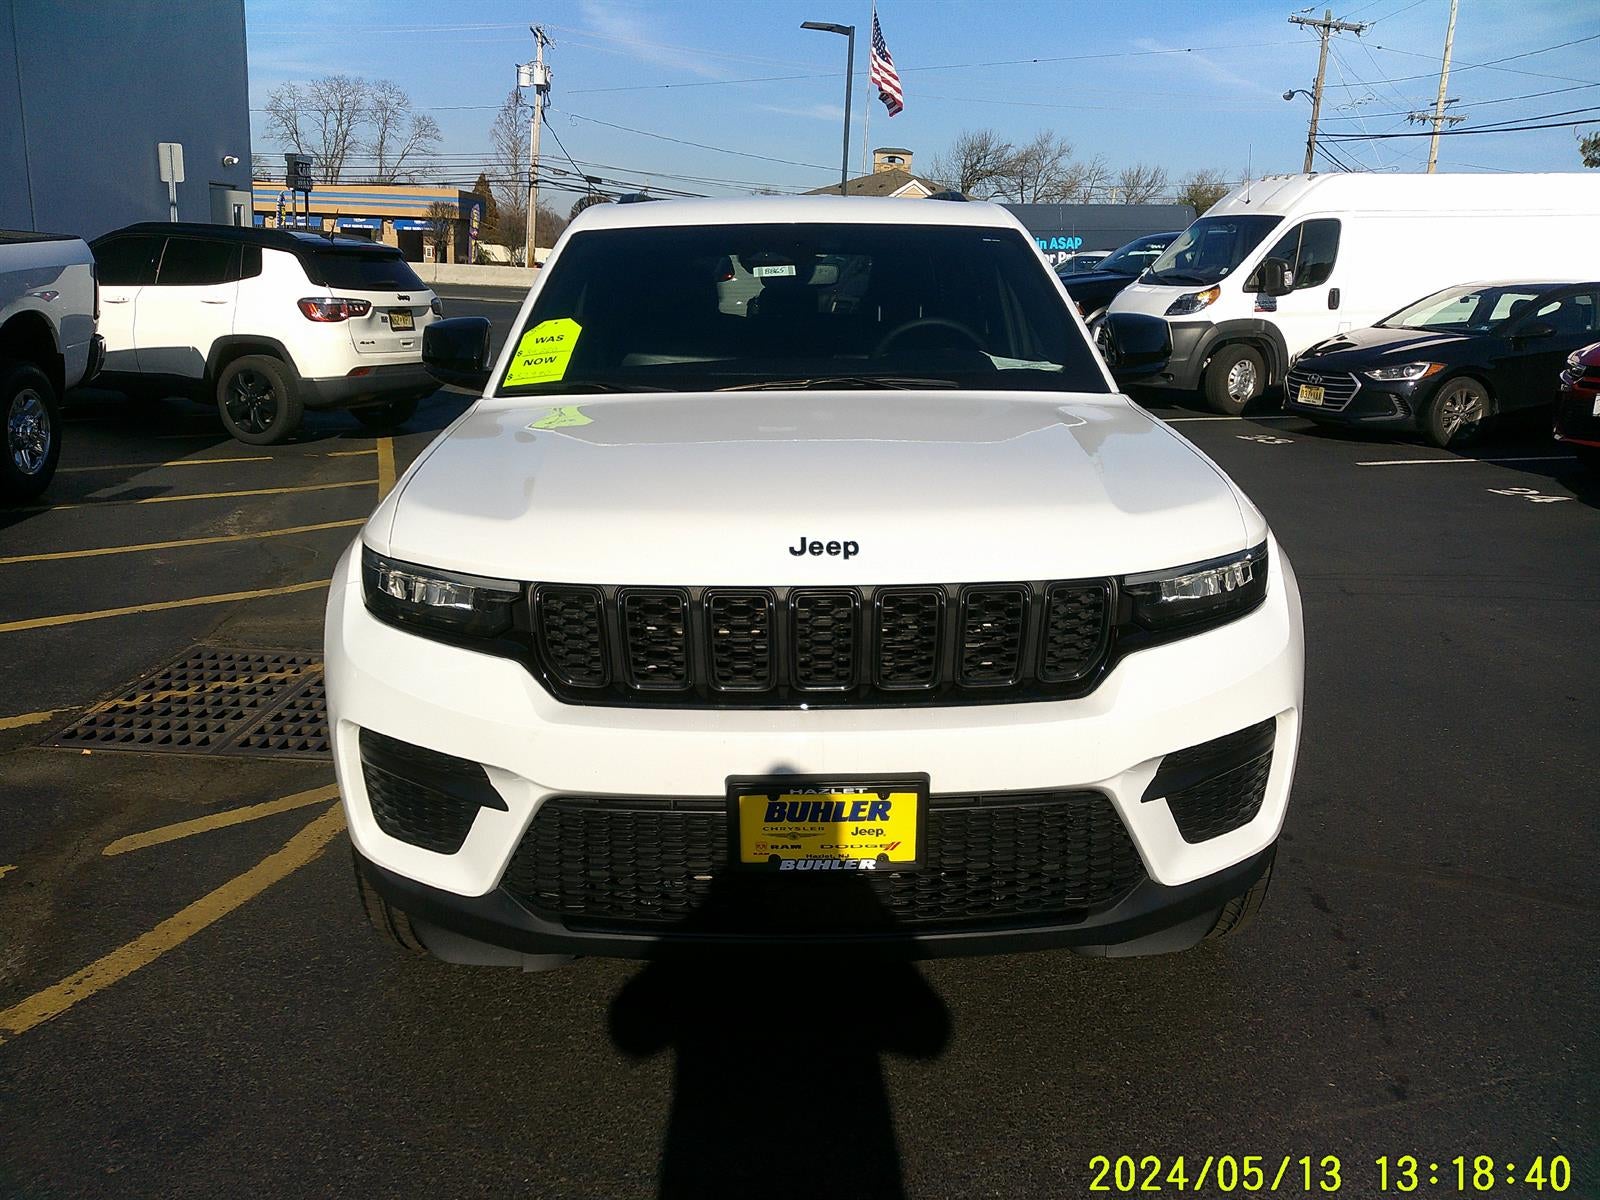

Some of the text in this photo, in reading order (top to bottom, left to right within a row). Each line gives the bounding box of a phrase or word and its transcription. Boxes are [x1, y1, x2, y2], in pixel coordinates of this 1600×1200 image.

[1049, 236, 1083, 250] ASAP
[535, 334, 565, 344] WAS
[523, 356, 557, 367] NOW
[788, 536, 860, 560] Jeep
[789, 787, 868, 795] HAZLET
[764, 800, 893, 823] BUHLER
[851, 826, 885, 837] Jeep
[779, 858, 877, 871] BUHLER
